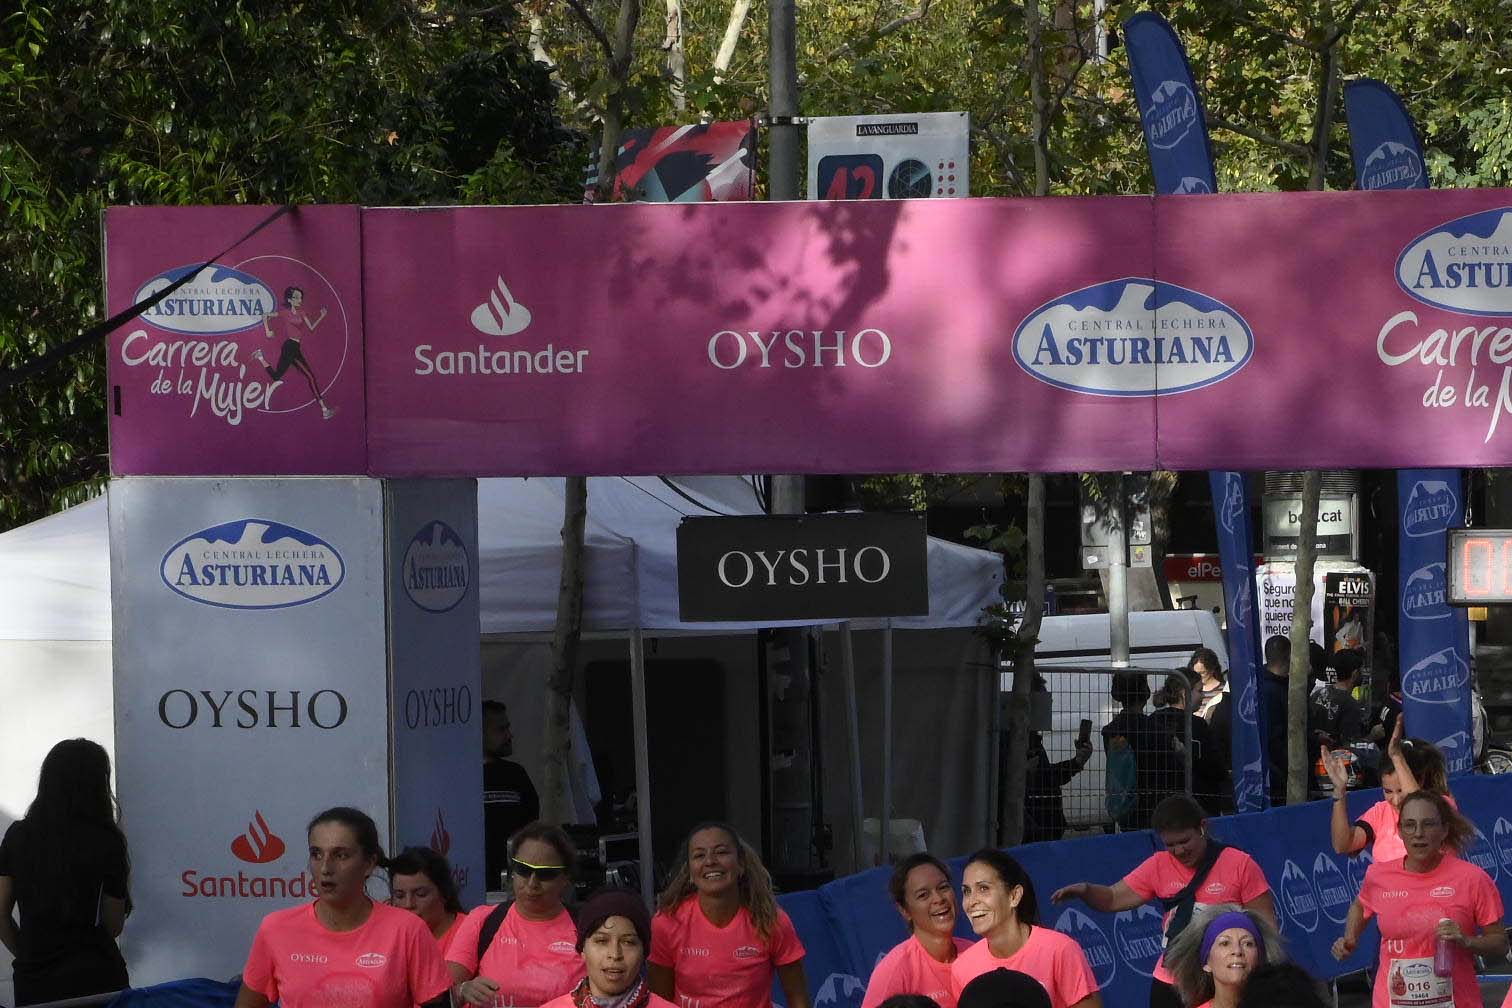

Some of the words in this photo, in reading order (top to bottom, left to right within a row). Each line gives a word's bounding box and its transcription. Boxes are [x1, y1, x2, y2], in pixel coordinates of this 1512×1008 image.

[146, 288, 264, 317] ASTURIANA
[215, 287, 261, 296] LECHERA
[1068, 319, 1143, 331] CENTRAL
[1150, 318, 1227, 330] LECHERA
[121, 330, 237, 367] Carrera
[415, 344, 589, 375] Santander
[708, 329, 892, 369] OYSHO
[1031, 323, 1235, 366] ASTURIANA
[151, 371, 176, 395] de
[177, 375, 193, 395] la
[191, 364, 283, 425] Mujer
[1422, 370, 1456, 408] de
[1465, 375, 1488, 407] la
[176, 552, 331, 587] ASTURIANA
[203, 550, 261, 560] CENTRAL
[266, 550, 325, 560] LECHERA
[718, 546, 892, 588] OYSHO
[408, 558, 466, 591] ASTURIANA
[1339, 582, 1369, 594] ELVIS
[1265, 598, 1281, 609] que
[157, 688, 348, 730] OYSHO
[405, 685, 472, 730] OYSHO
[182, 869, 316, 899] Santande
[290, 953, 327, 964] OYSHO
[1408, 982, 1430, 991] 016
